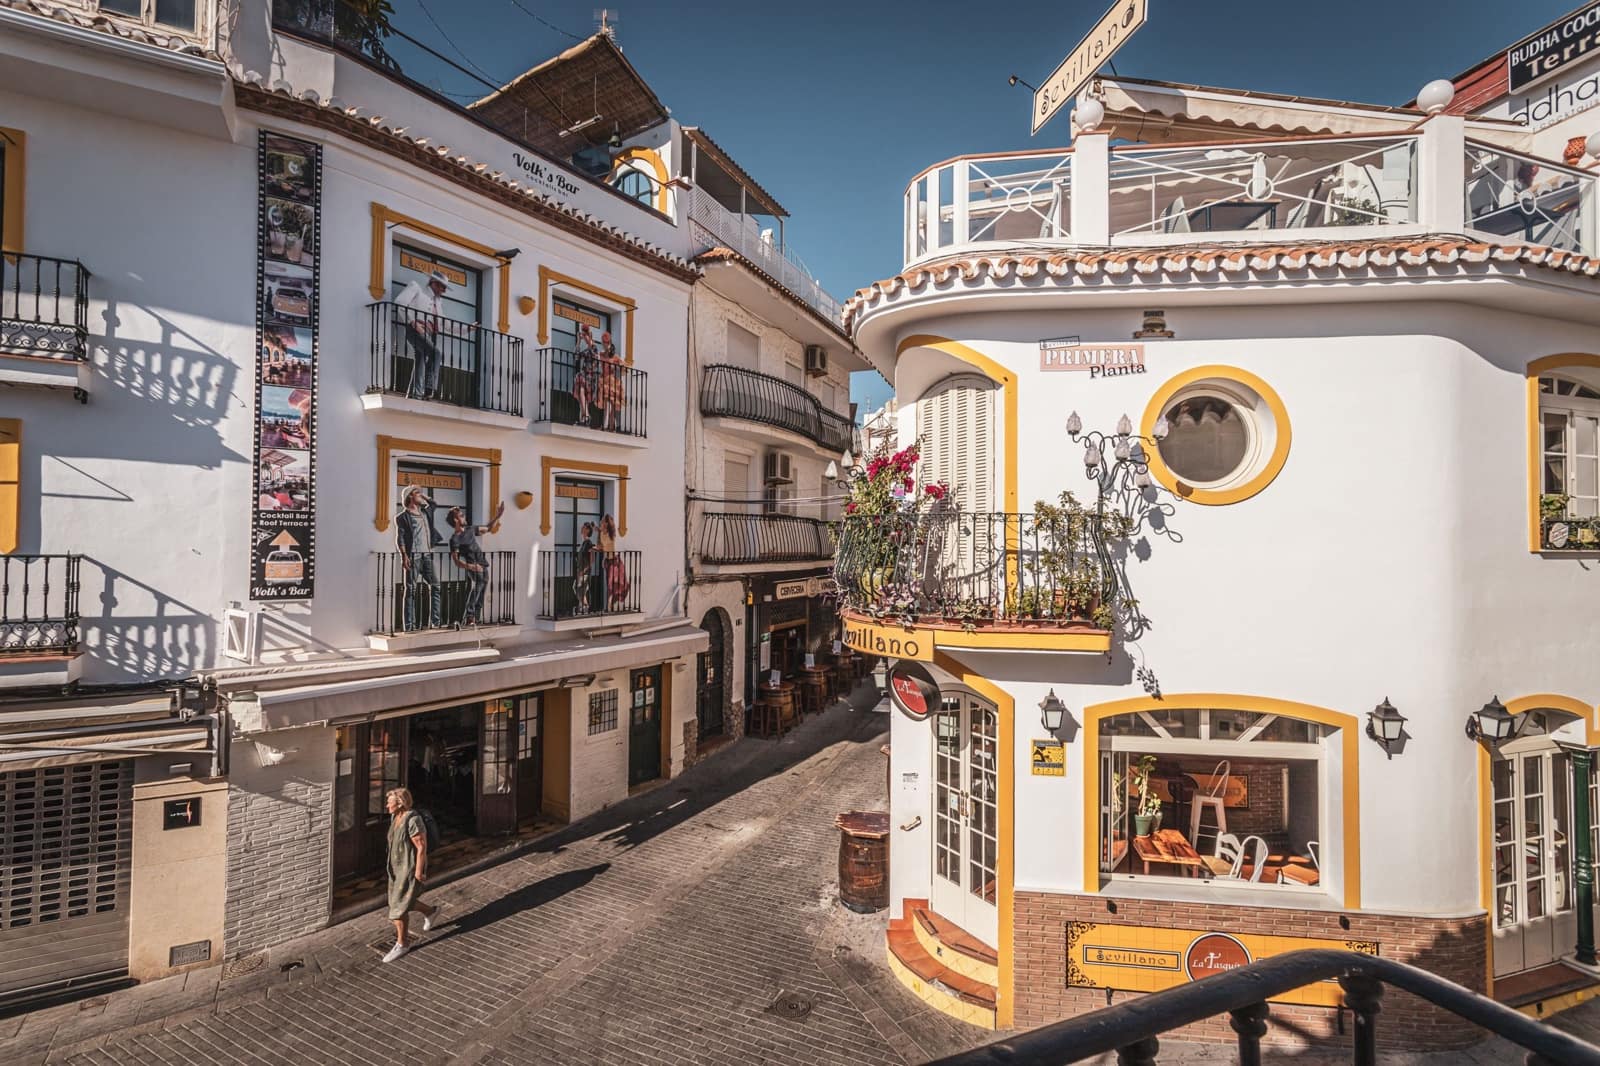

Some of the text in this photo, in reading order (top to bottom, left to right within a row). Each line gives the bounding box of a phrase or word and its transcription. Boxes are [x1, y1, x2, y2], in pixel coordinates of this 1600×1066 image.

[1511, 30, 1561, 67] BUDHA
[1041, 4, 1136, 116] Sevillano
[512, 153, 580, 195] Volk's Bar
[1046, 349, 1139, 366] PRIMERA
[1089, 362, 1147, 380] Planta
[252, 586, 310, 596] Volk's Bar
[1096, 949, 1167, 966] Sevillano
[1192, 959, 1204, 968] La
